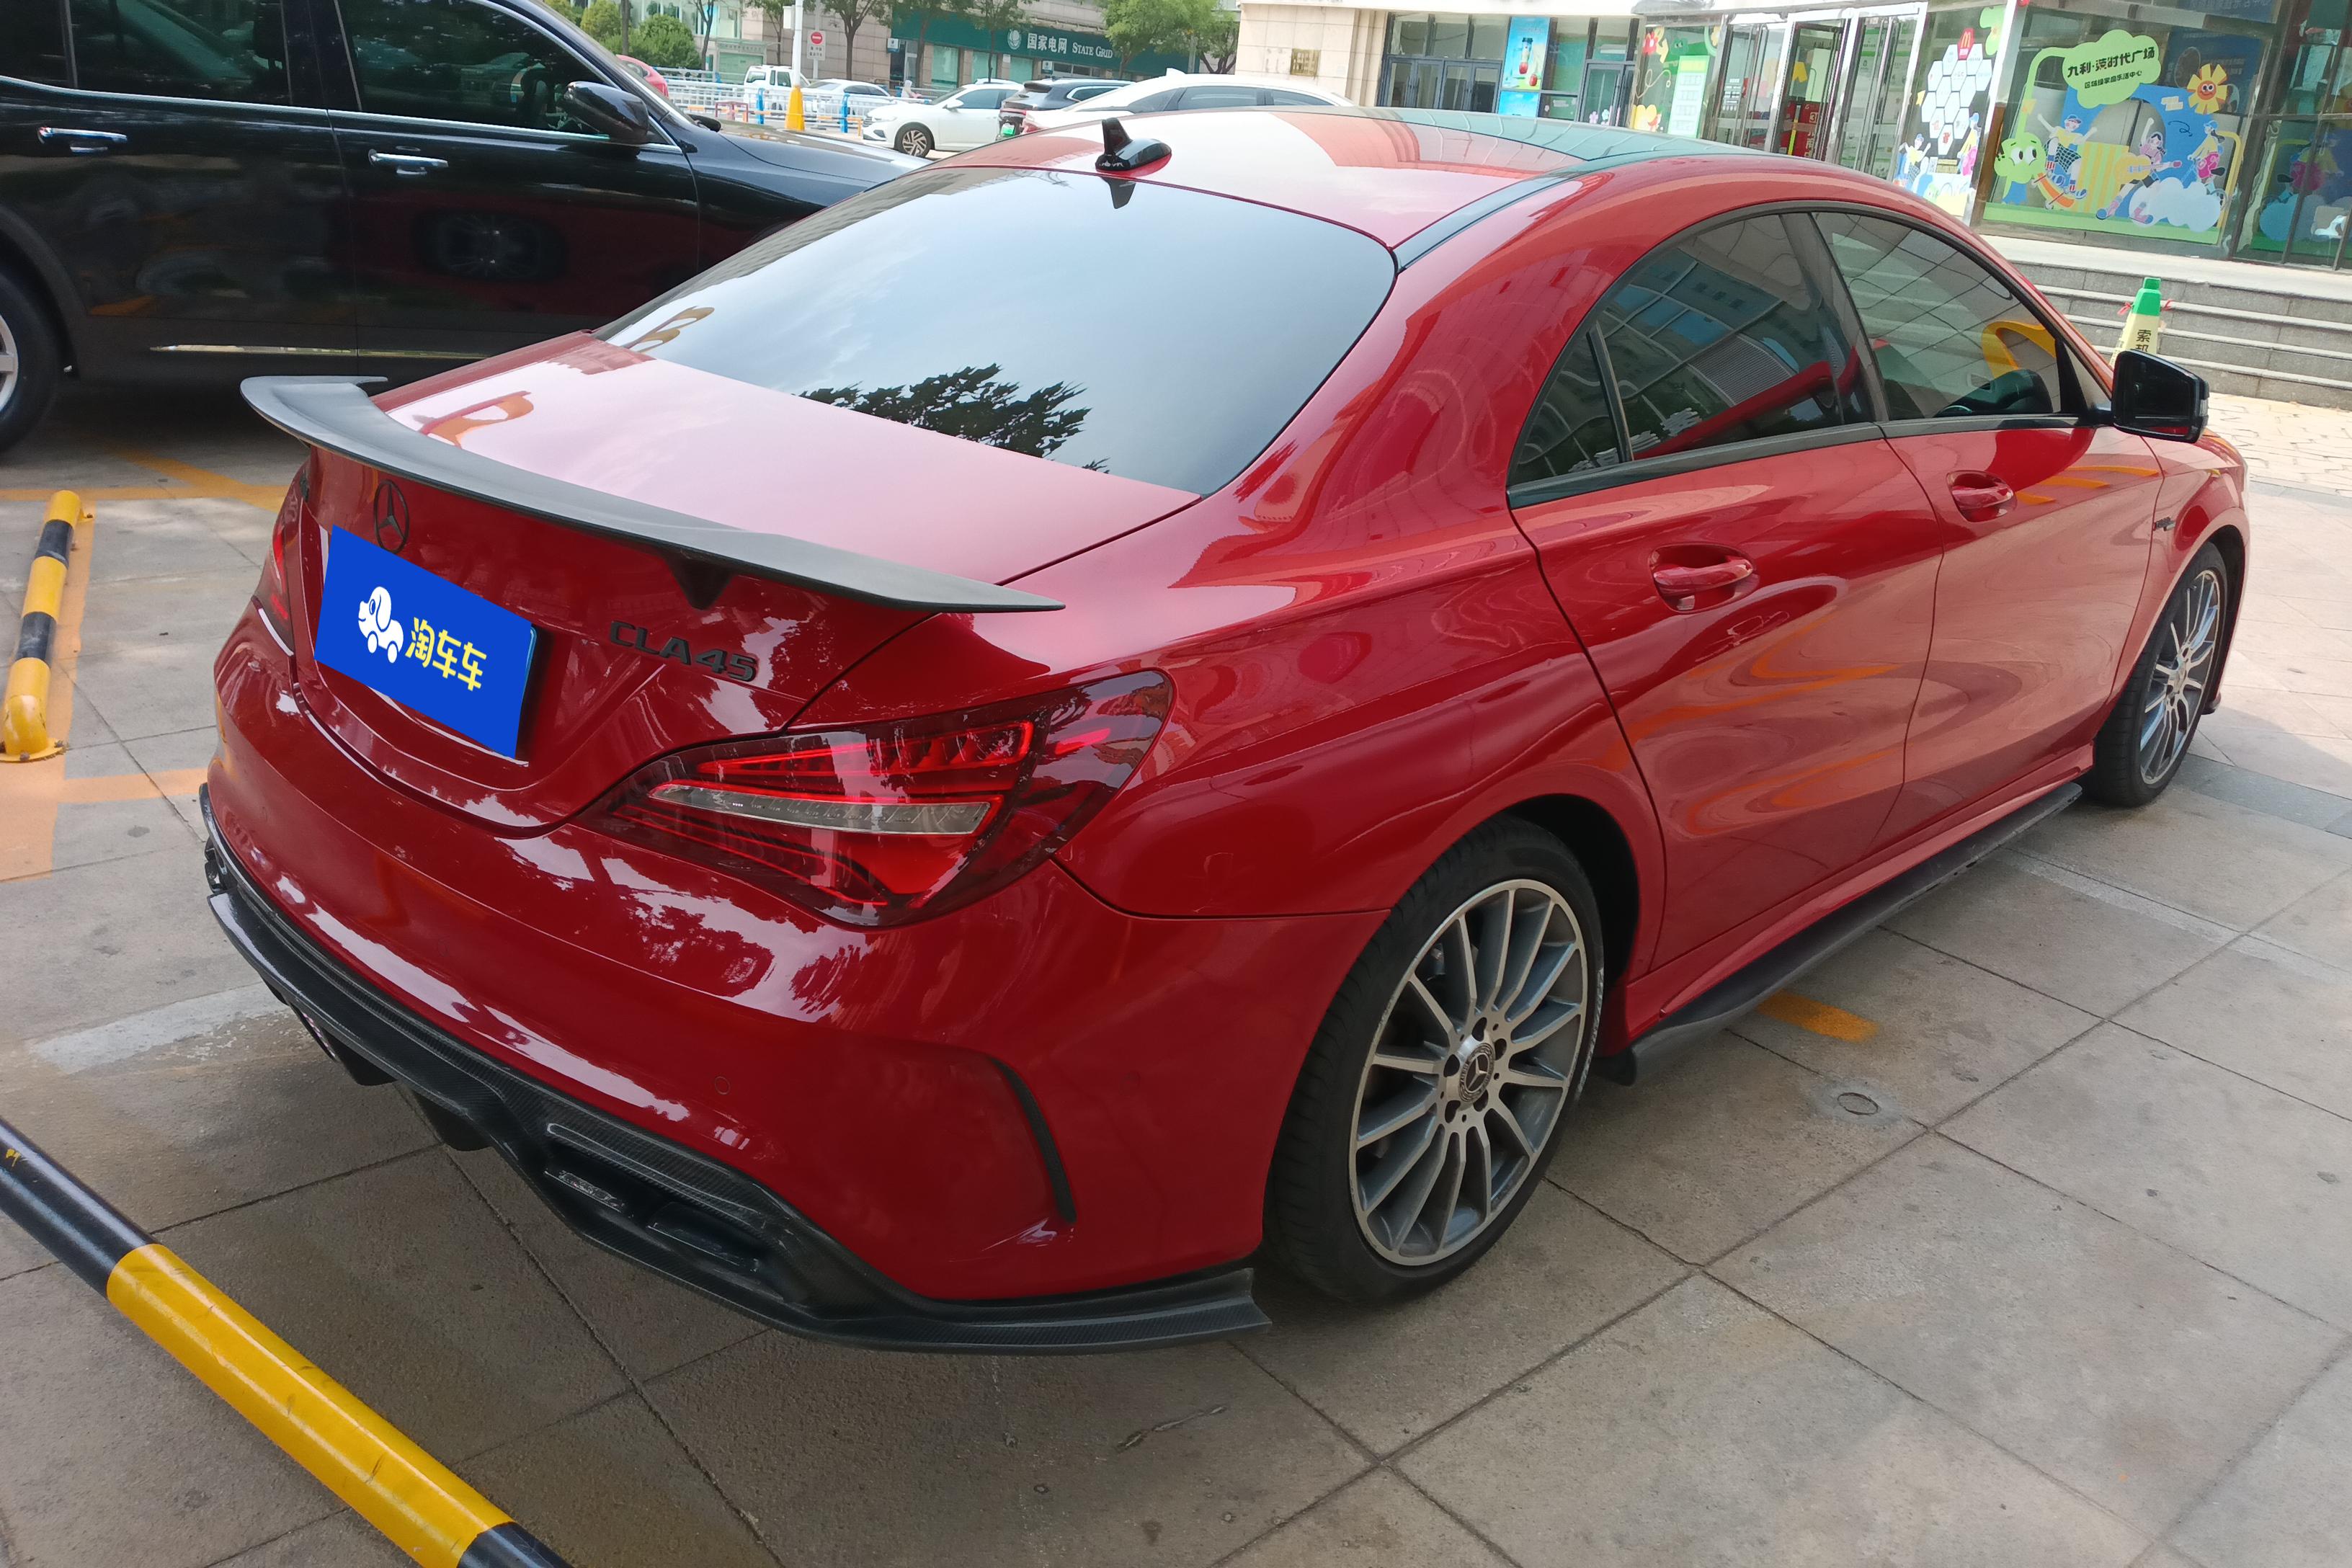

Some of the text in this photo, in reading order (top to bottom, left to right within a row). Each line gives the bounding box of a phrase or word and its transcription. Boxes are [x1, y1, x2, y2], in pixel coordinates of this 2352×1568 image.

[1027, 33, 1067, 54] 国家电网
[1072, 42, 1113, 58] STATE GRID
